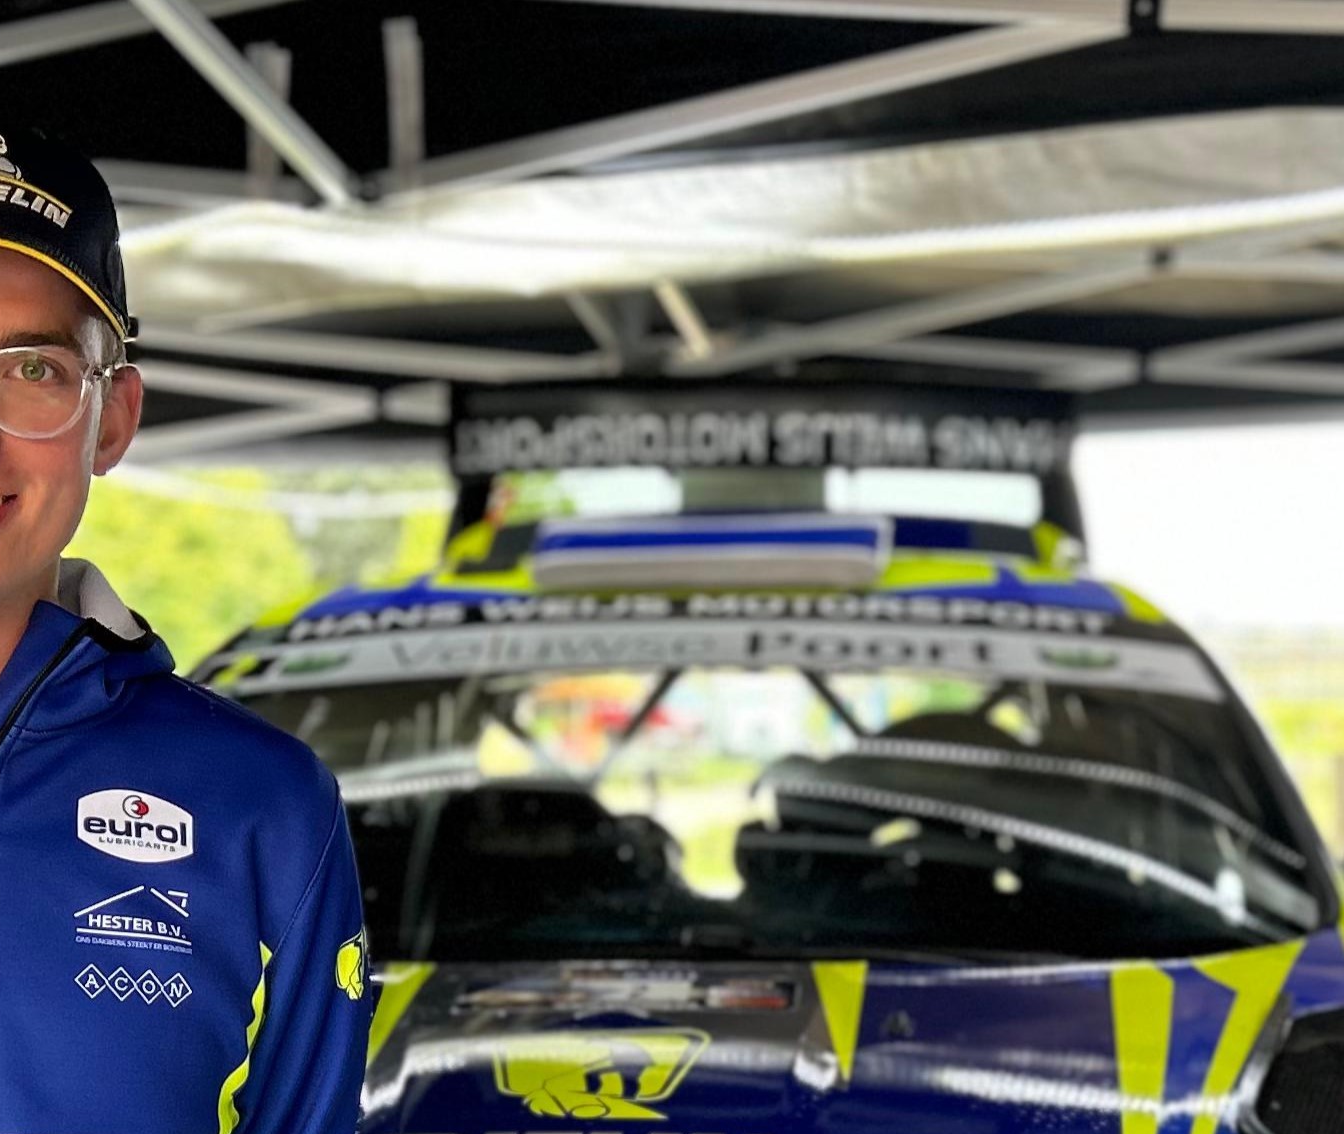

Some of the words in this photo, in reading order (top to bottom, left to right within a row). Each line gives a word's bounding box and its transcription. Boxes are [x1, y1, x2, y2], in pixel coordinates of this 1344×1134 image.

[456, 411, 768, 473] MOTORSPORT
[288, 603, 465, 643] HANS
[685, 593, 1108, 633] MOTORSPORT
[747, 628, 992, 661] Poort
[83, 814, 188, 847] eurol
[98, 835, 176, 852] LUBRICANTS
[88, 913, 153, 932] HESTER
[157, 921, 187, 939] B.V.
[84, 973, 184, 998] ACON
